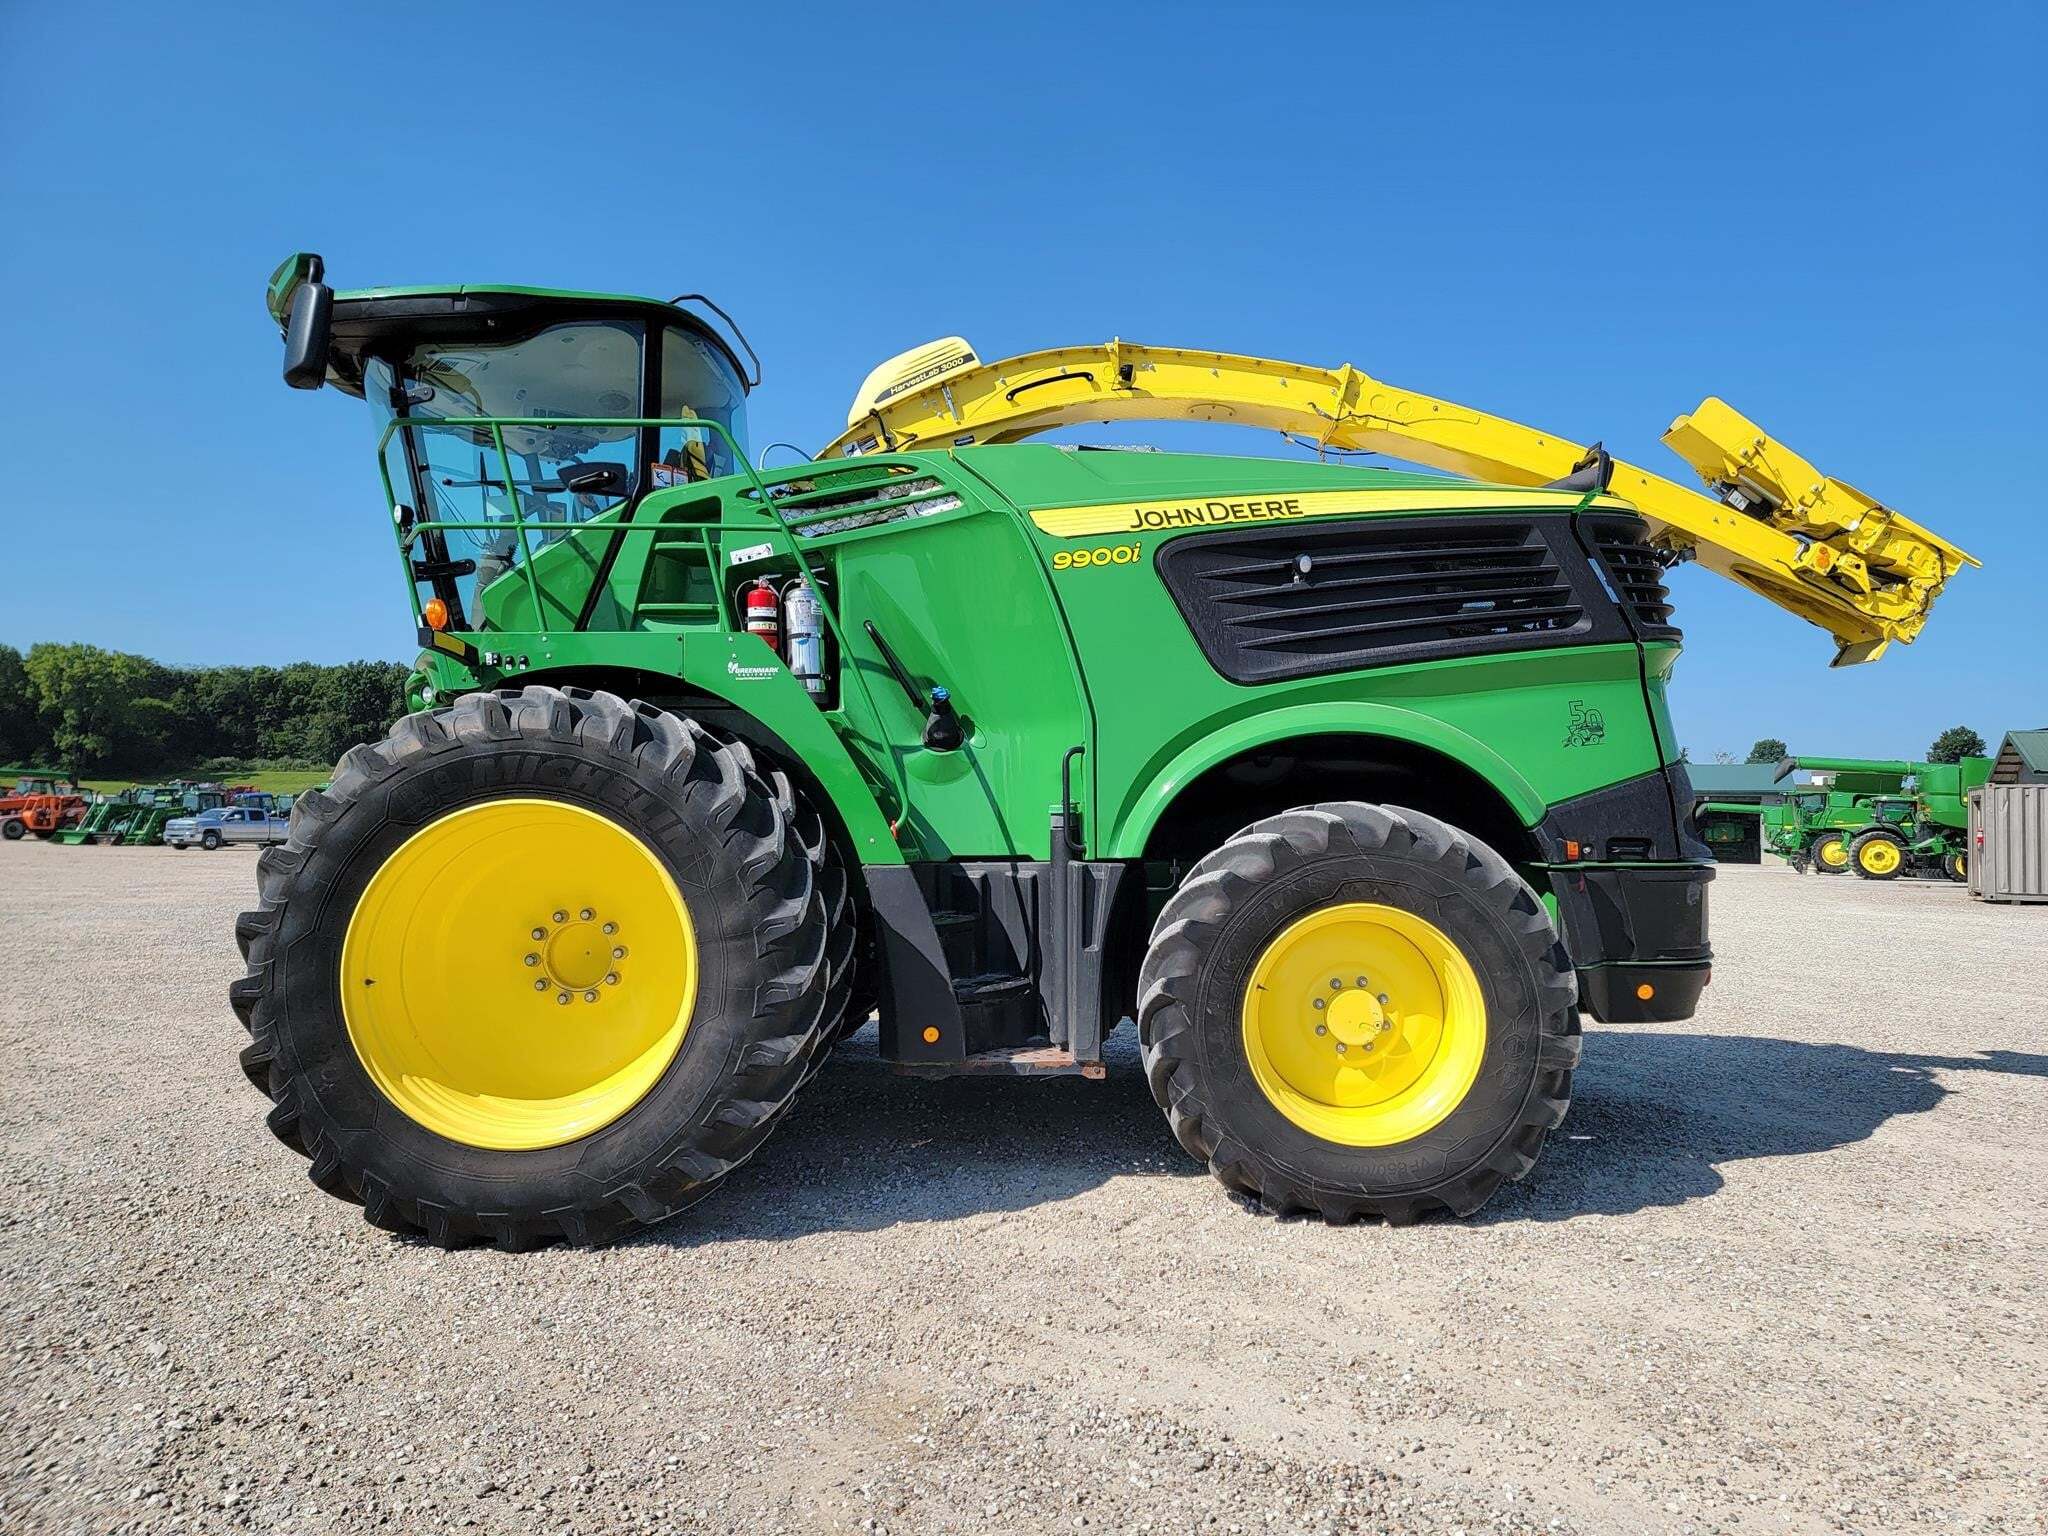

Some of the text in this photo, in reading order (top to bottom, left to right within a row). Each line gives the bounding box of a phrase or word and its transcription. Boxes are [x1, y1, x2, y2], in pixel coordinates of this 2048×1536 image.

[890, 357, 964, 395] HarvestLab 3000
[1130, 499, 1304, 529] JOHN DEERE
[1053, 542, 1142, 571] 9900i
[1568, 699, 1603, 728] 50
[471, 754, 702, 866] MICHELIN
